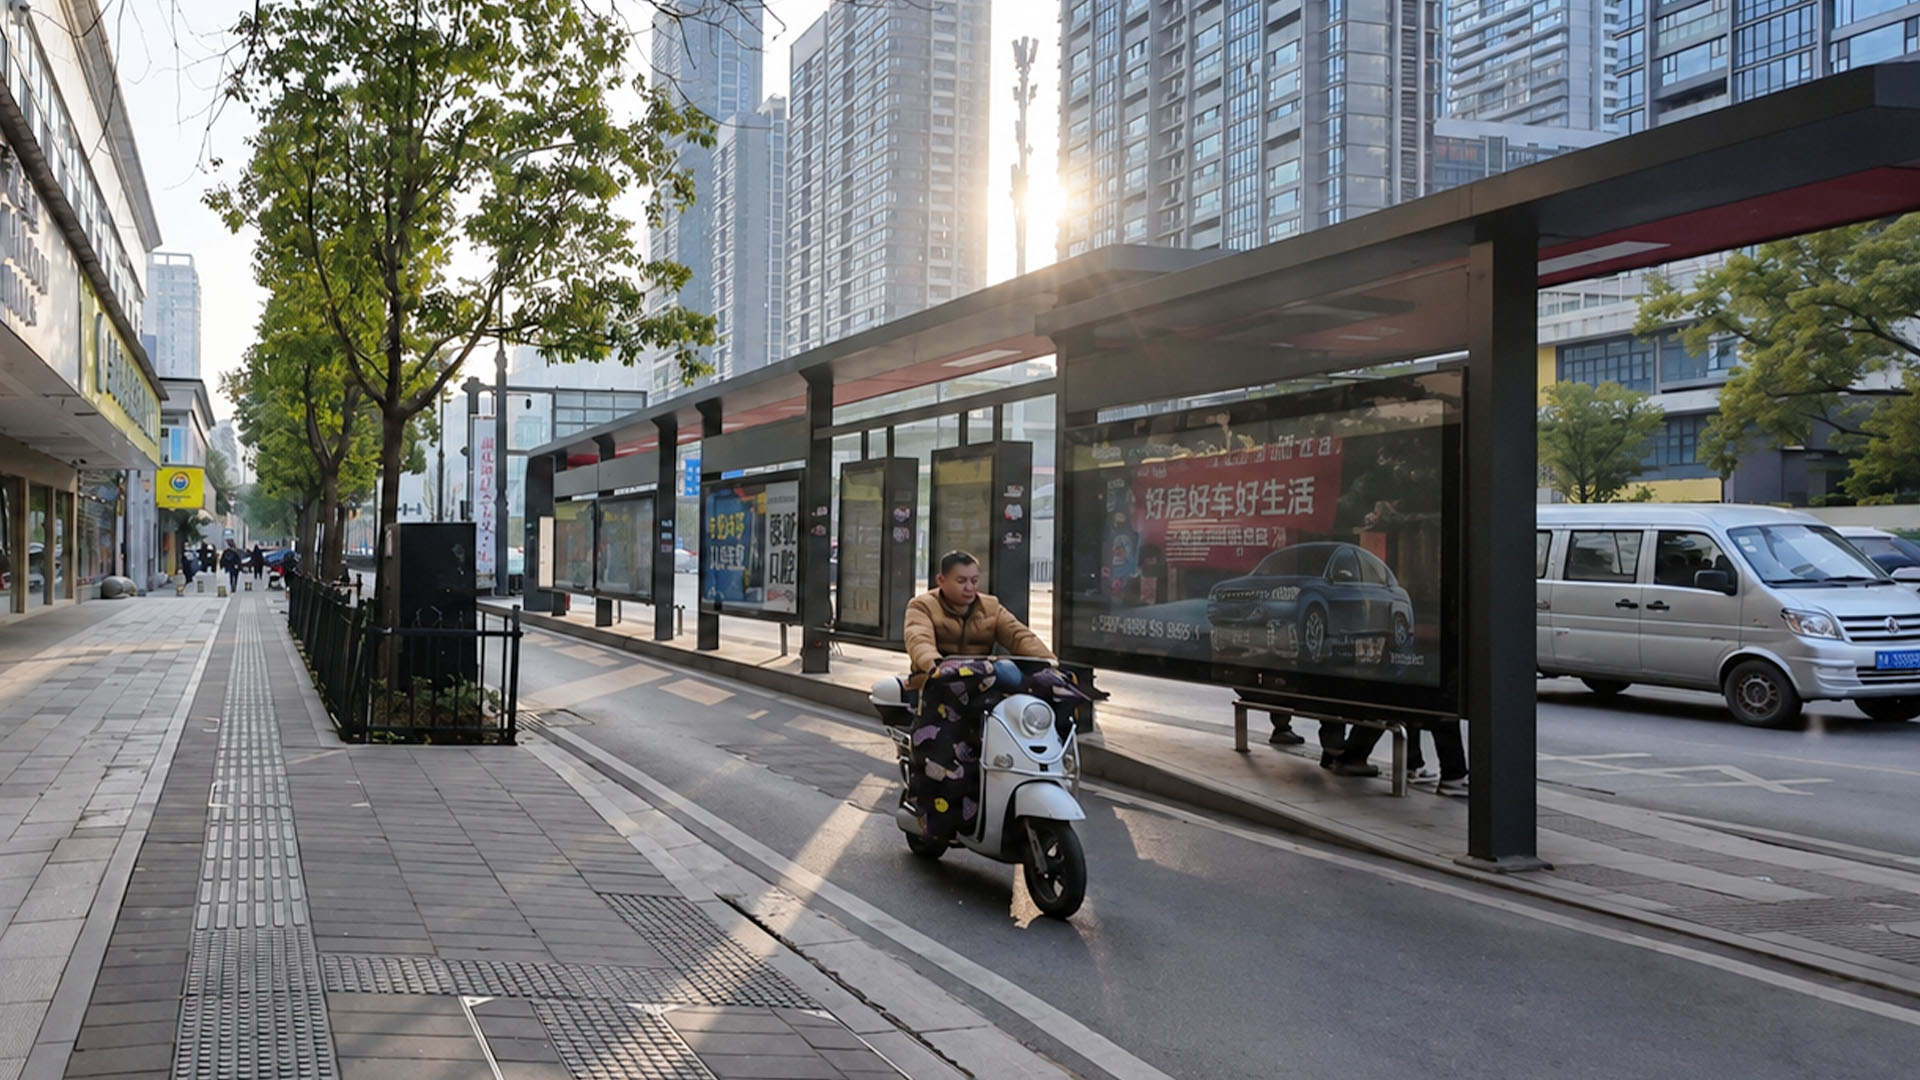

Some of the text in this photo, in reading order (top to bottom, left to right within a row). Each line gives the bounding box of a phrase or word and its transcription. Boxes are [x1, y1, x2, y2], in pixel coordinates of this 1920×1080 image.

[1145, 476, 1315, 520] 好房好车好生活
